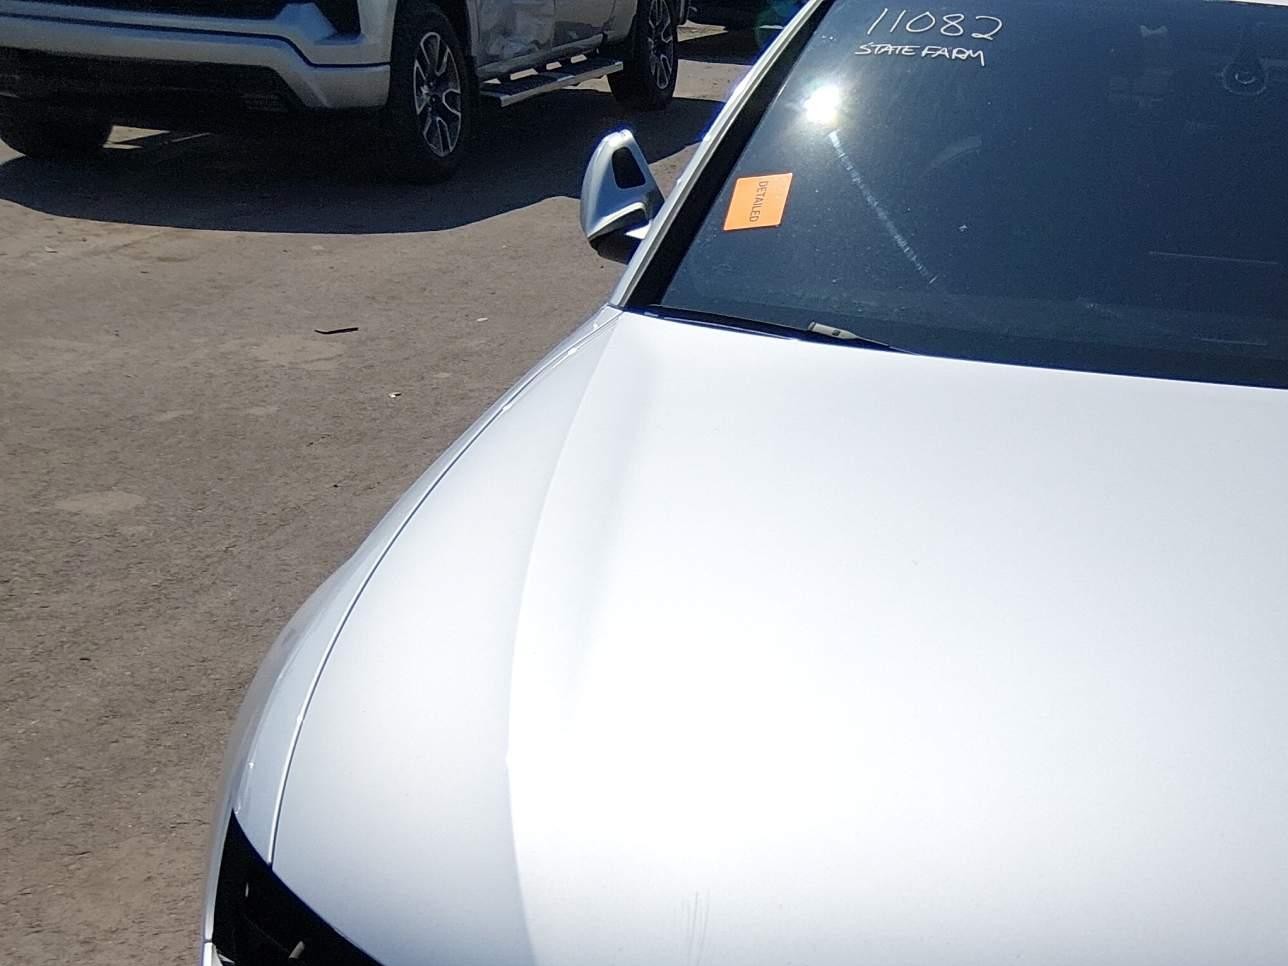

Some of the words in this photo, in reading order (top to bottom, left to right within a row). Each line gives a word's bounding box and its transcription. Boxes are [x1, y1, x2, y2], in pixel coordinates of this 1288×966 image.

[866, 7, 1003, 41] 11082
[854, 41, 920, 56] STATE
[921, 45, 985, 67] FARM
[749, 180, 769, 223] DETAILED
